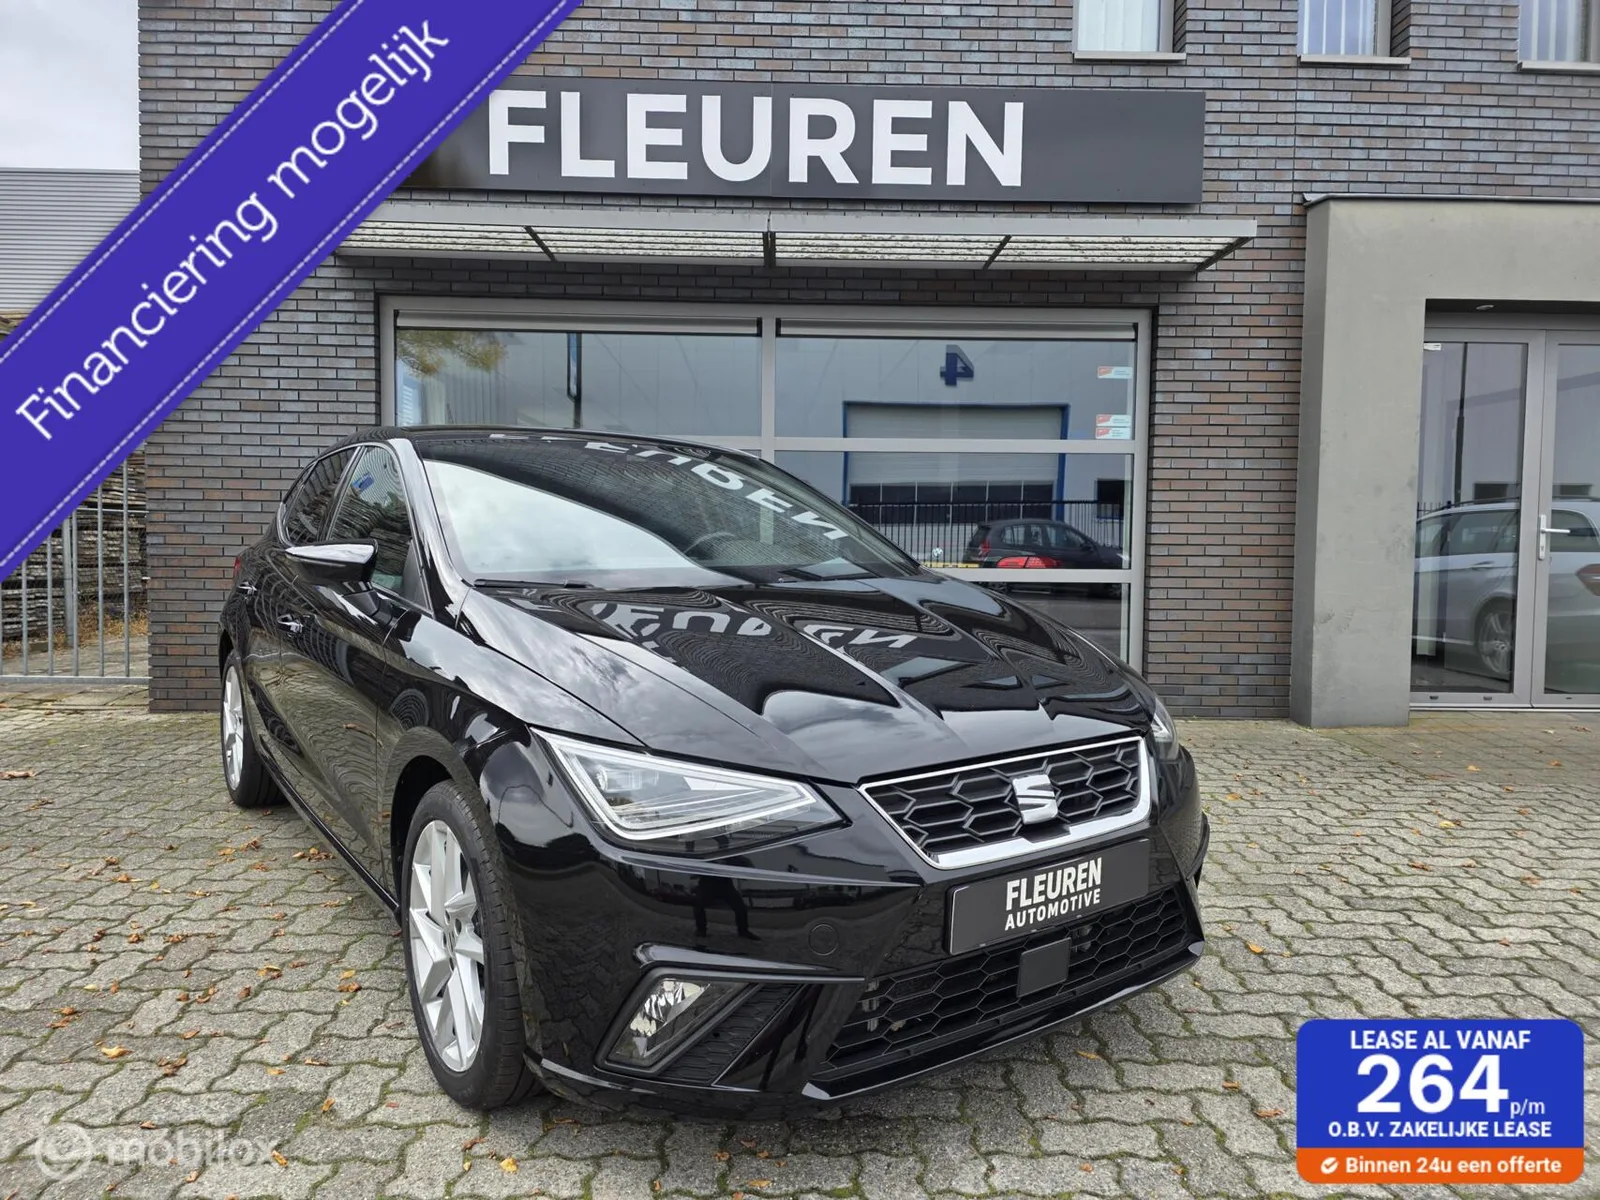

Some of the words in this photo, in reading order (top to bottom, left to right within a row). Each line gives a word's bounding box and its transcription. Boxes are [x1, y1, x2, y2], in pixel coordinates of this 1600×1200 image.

[488, 89, 1024, 187] FLEUREN
[1004, 888, 1101, 931] AUTOMOTIVE
[1005, 857, 1103, 911] FLEUREN
